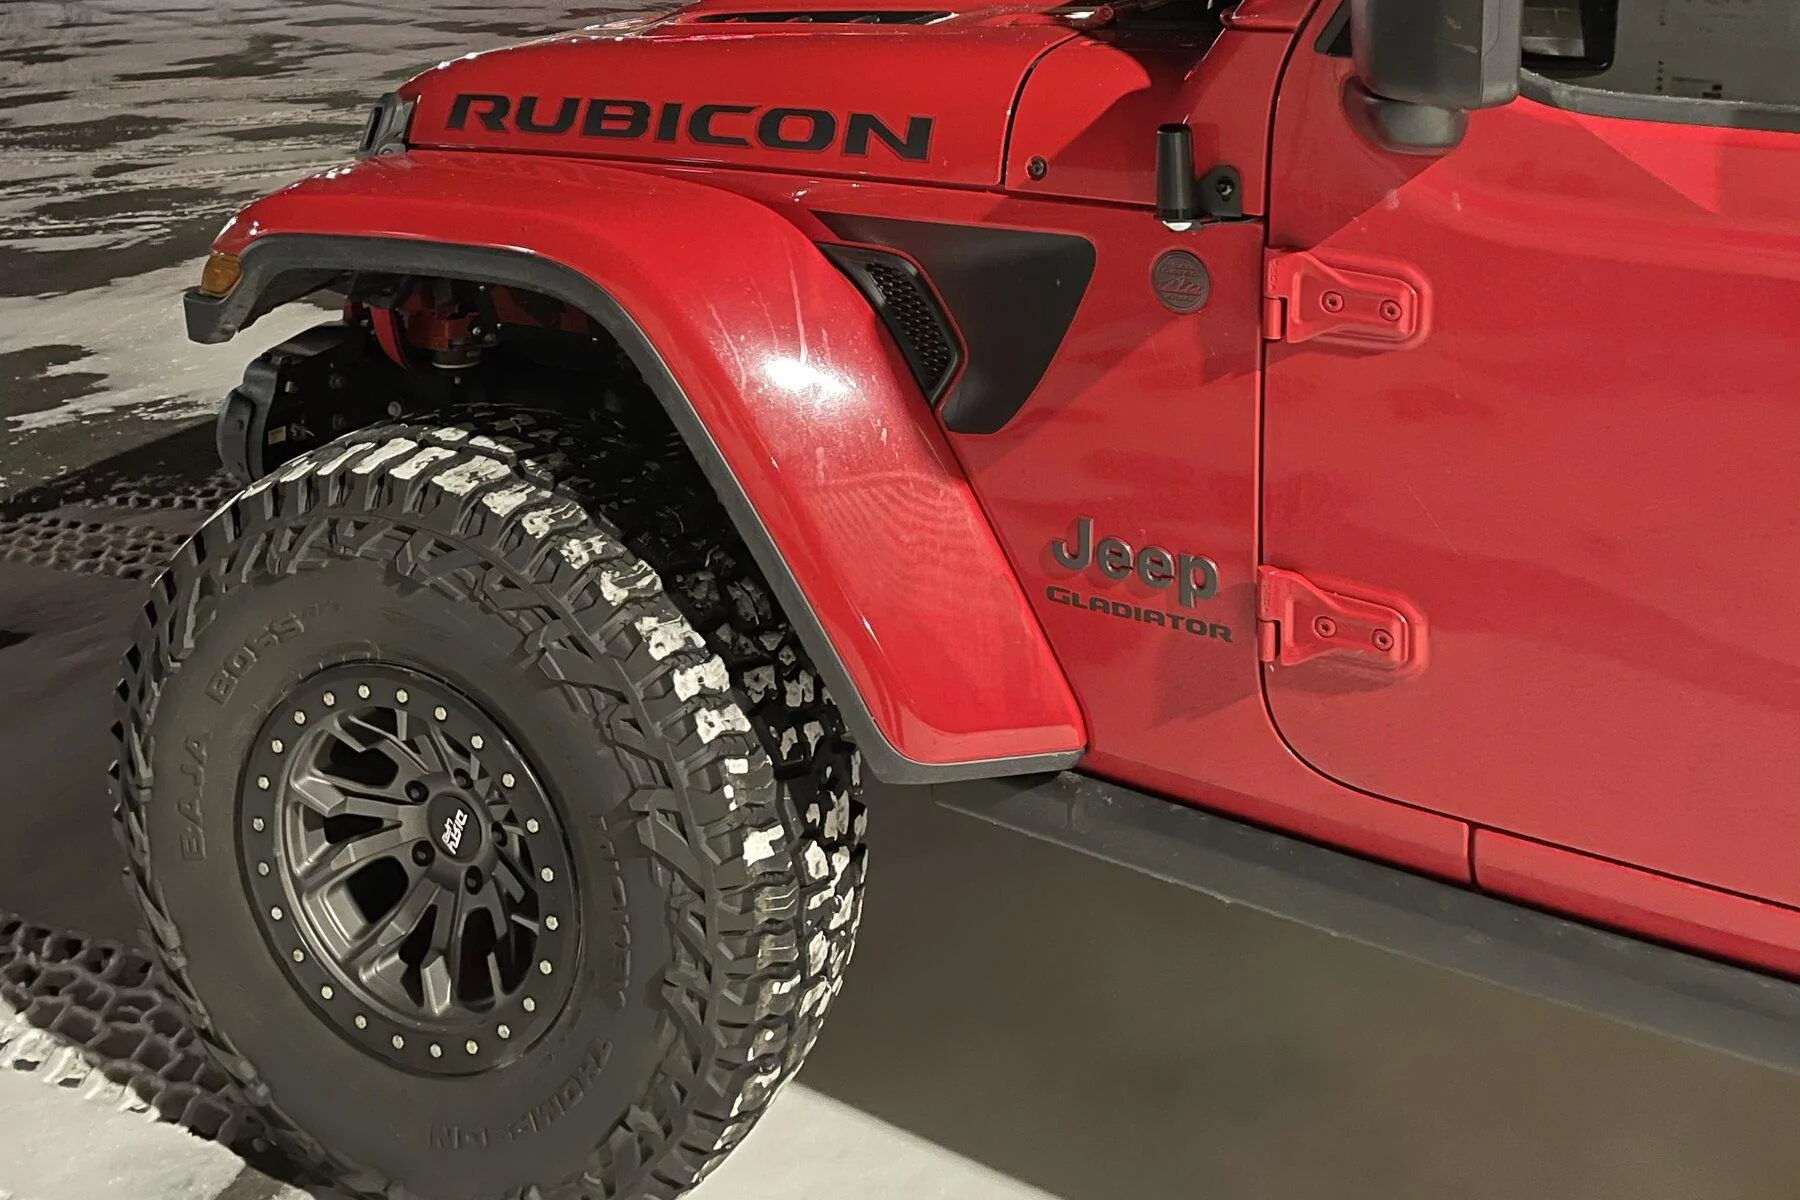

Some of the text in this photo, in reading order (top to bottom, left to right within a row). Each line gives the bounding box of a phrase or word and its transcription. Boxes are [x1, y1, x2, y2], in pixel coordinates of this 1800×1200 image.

[446, 93, 935, 162] RUBICON
[1052, 516, 1221, 609] Jeep
[1046, 585, 1233, 643] GLADIATOR
